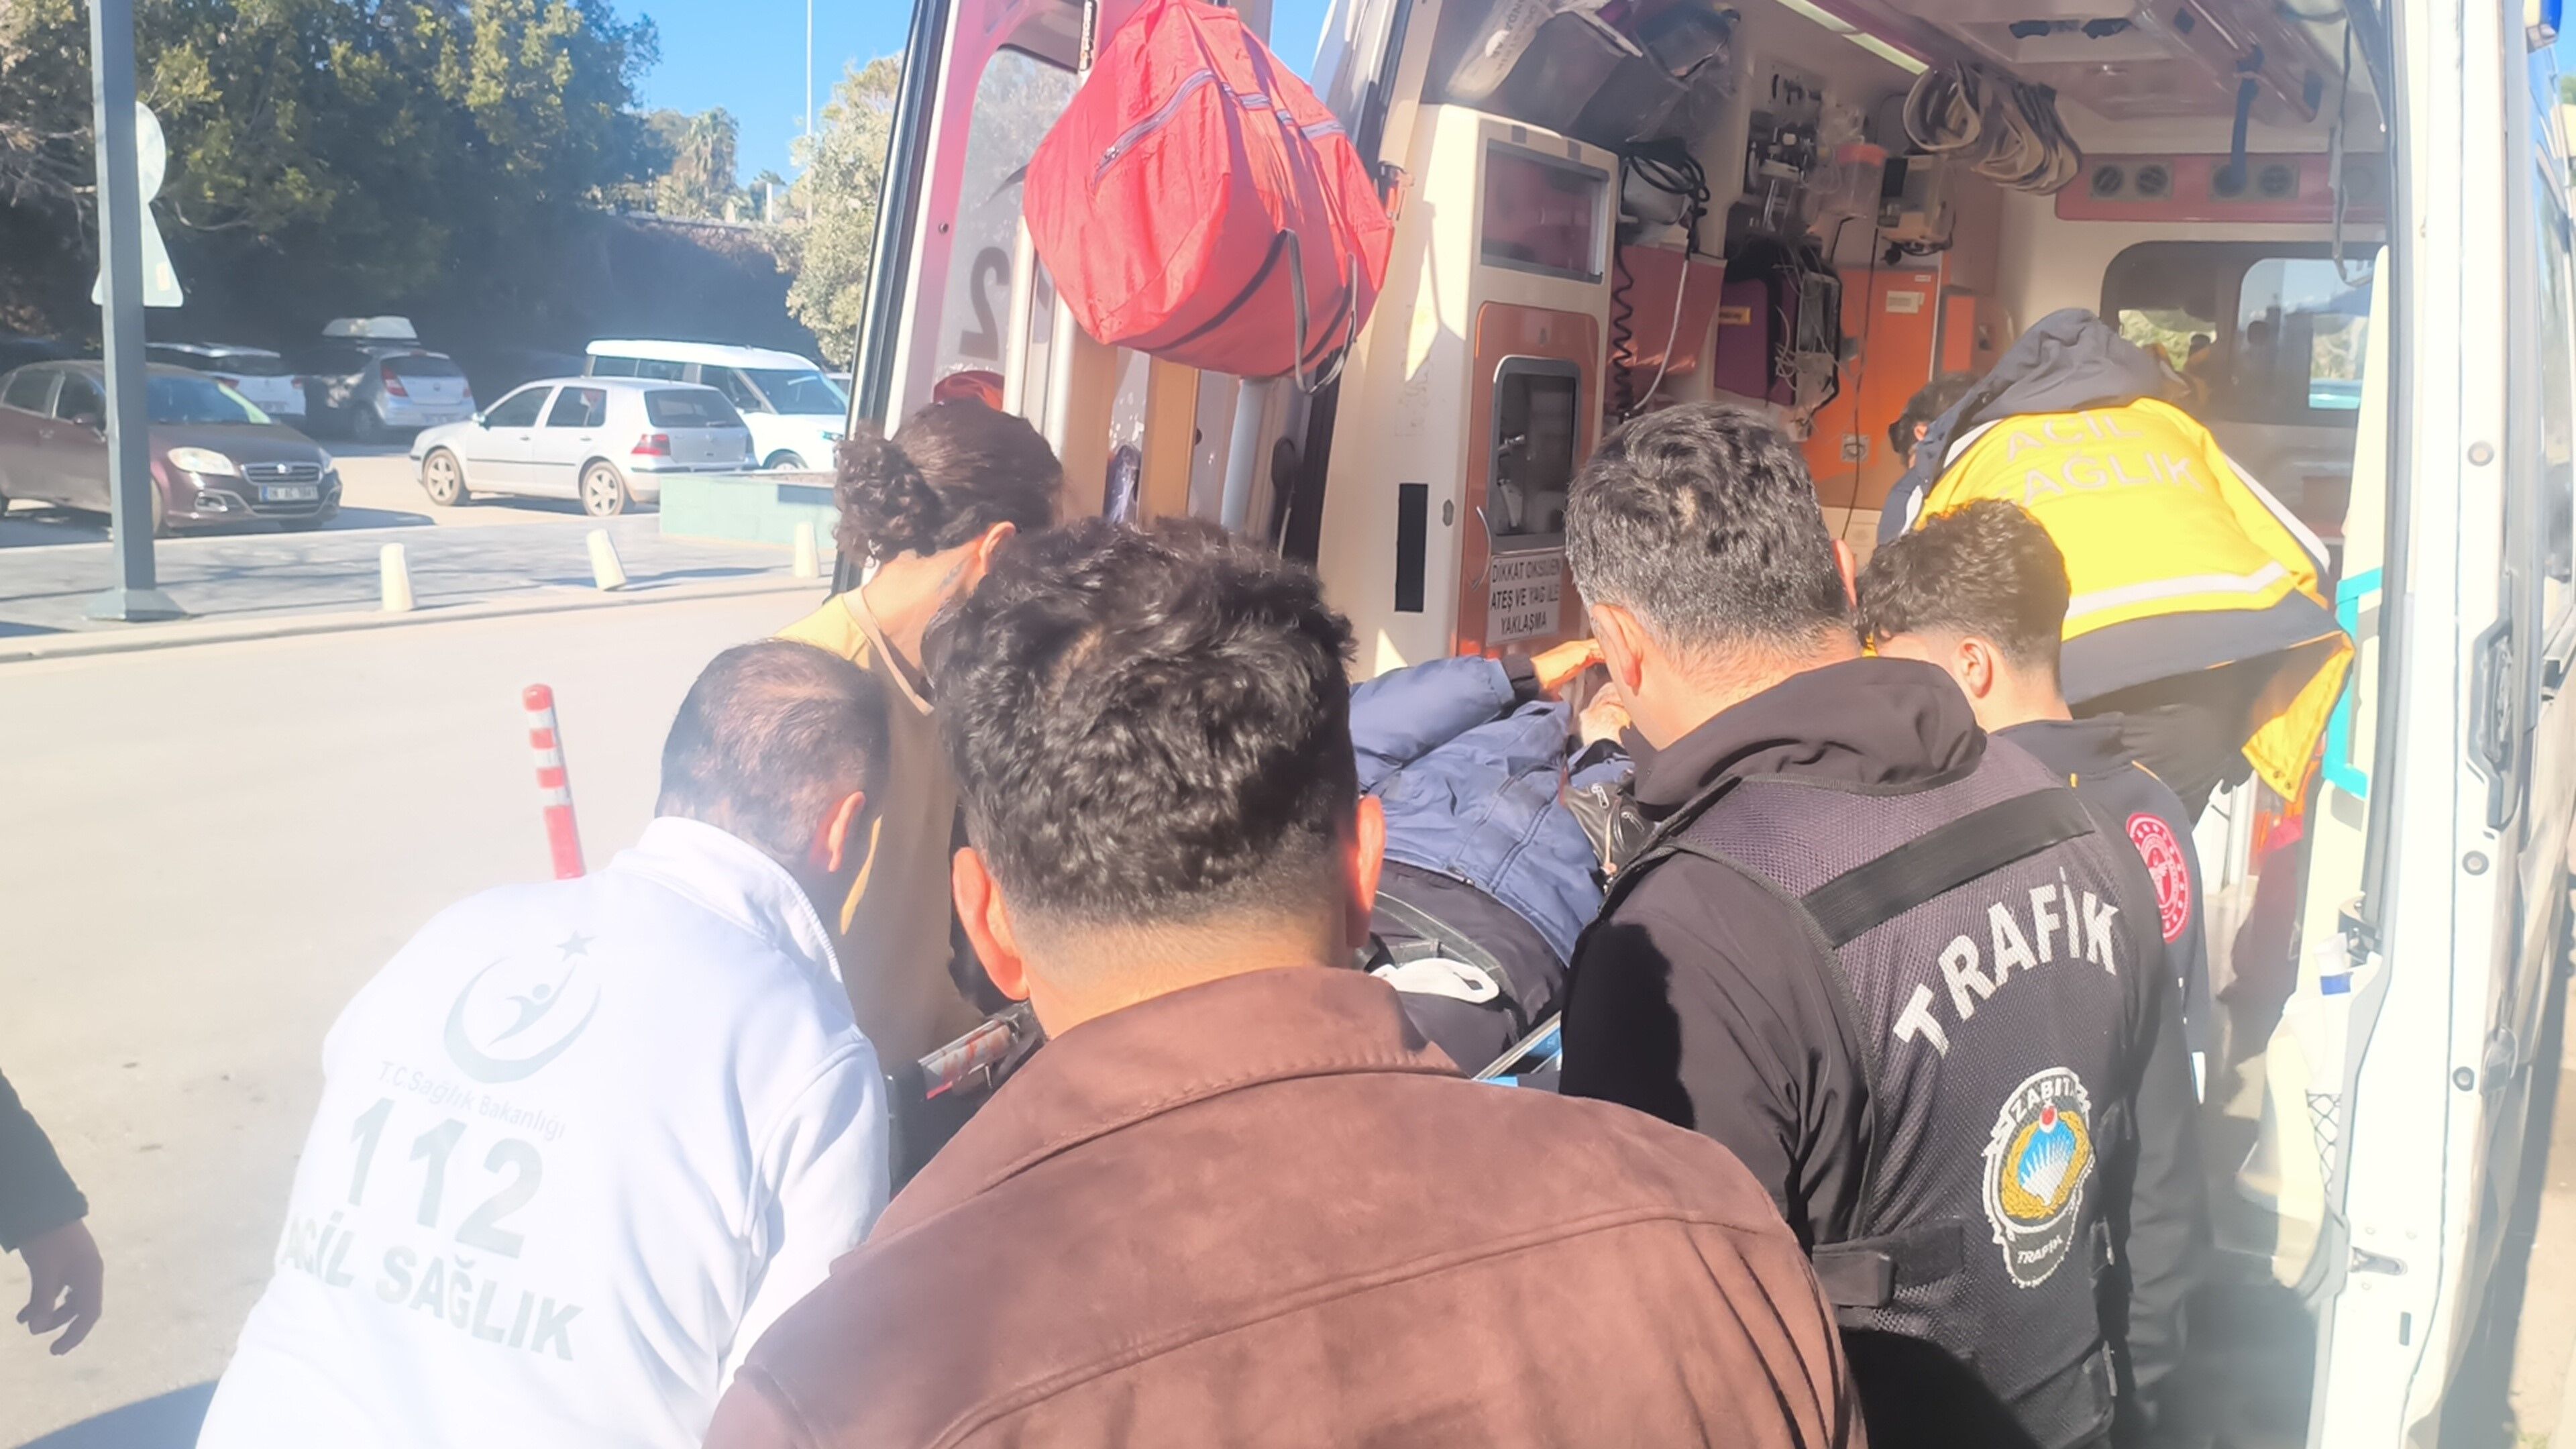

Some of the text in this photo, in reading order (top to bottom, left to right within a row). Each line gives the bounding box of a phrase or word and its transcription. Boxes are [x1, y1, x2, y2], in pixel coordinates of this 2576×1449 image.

[1996, 448, 2205, 508] AĞLIK
[1491, 560, 1525, 583] DİKKAT
[1490, 590, 1513, 612] ATEŞ
[1515, 588, 1527, 607] VE
[1501, 611, 1546, 635] YAKLAŞMA
[1893, 866, 2121, 1057] TRAFİK
[478, 1095, 567, 1142] Bakanlığı
[2012, 1077, 2075, 1122] ZABIT
[348, 1096, 544, 1260] 112
[375, 1244, 585, 1362] SAĞLIK
